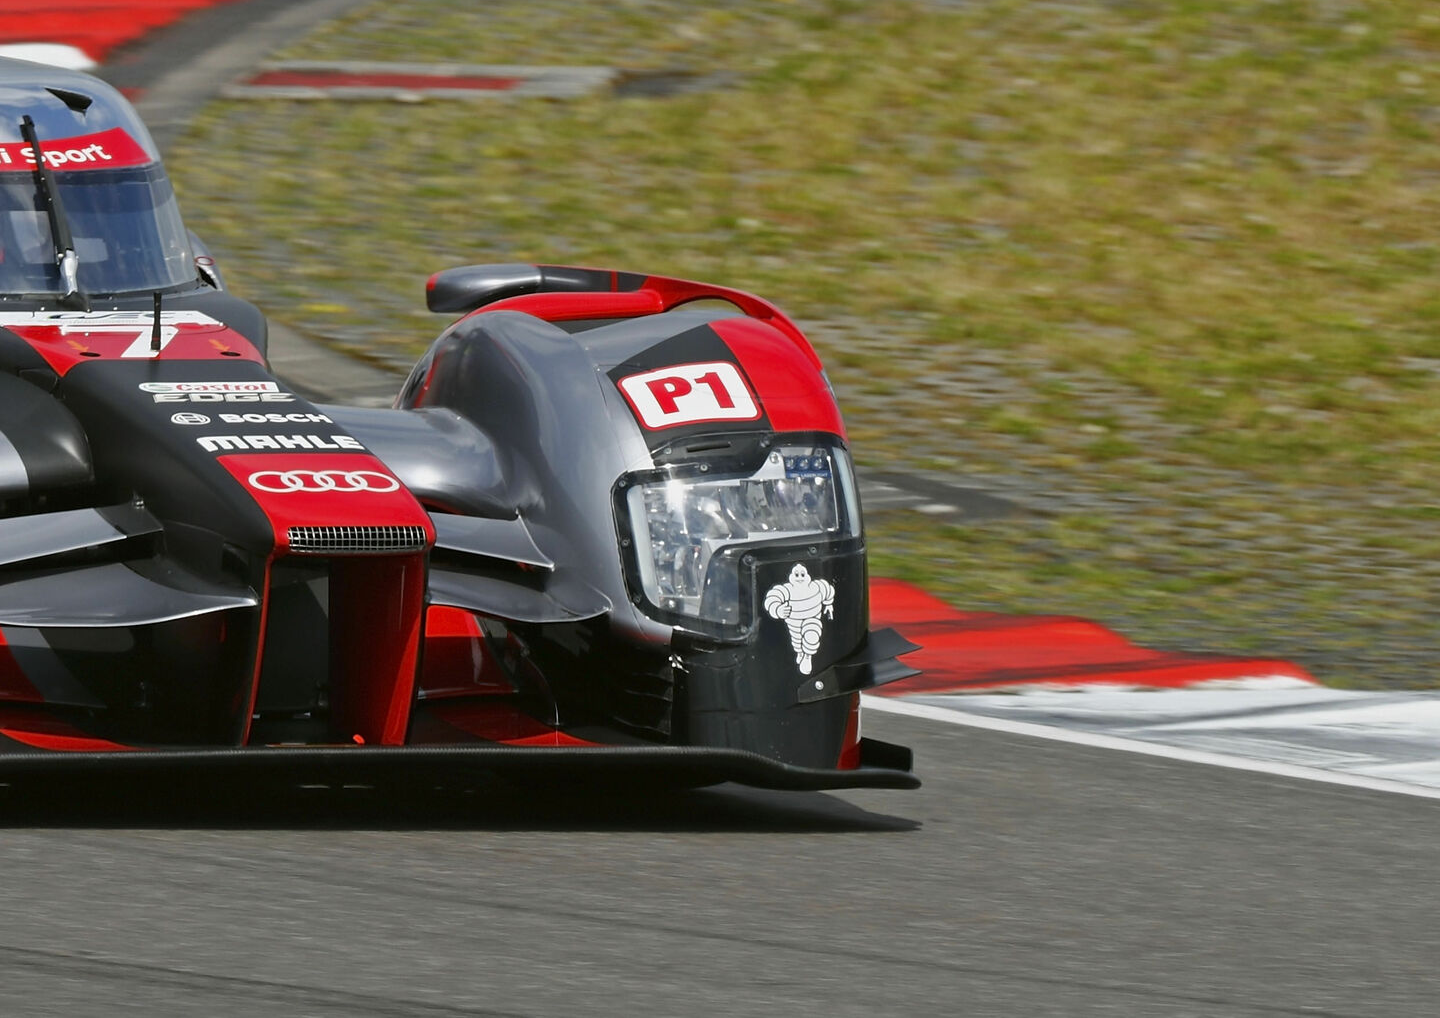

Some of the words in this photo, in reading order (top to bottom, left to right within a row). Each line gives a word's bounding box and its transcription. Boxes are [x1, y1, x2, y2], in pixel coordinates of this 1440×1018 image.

[20, 143, 112, 168] Sport
[59, 324, 179, 358] 7
[176, 383, 270, 392] Castrol
[645, 371, 736, 414] P1
[153, 392, 297, 404] EDGE
[218, 413, 334, 424] BOSCH
[196, 435, 366, 453] MAHLE
